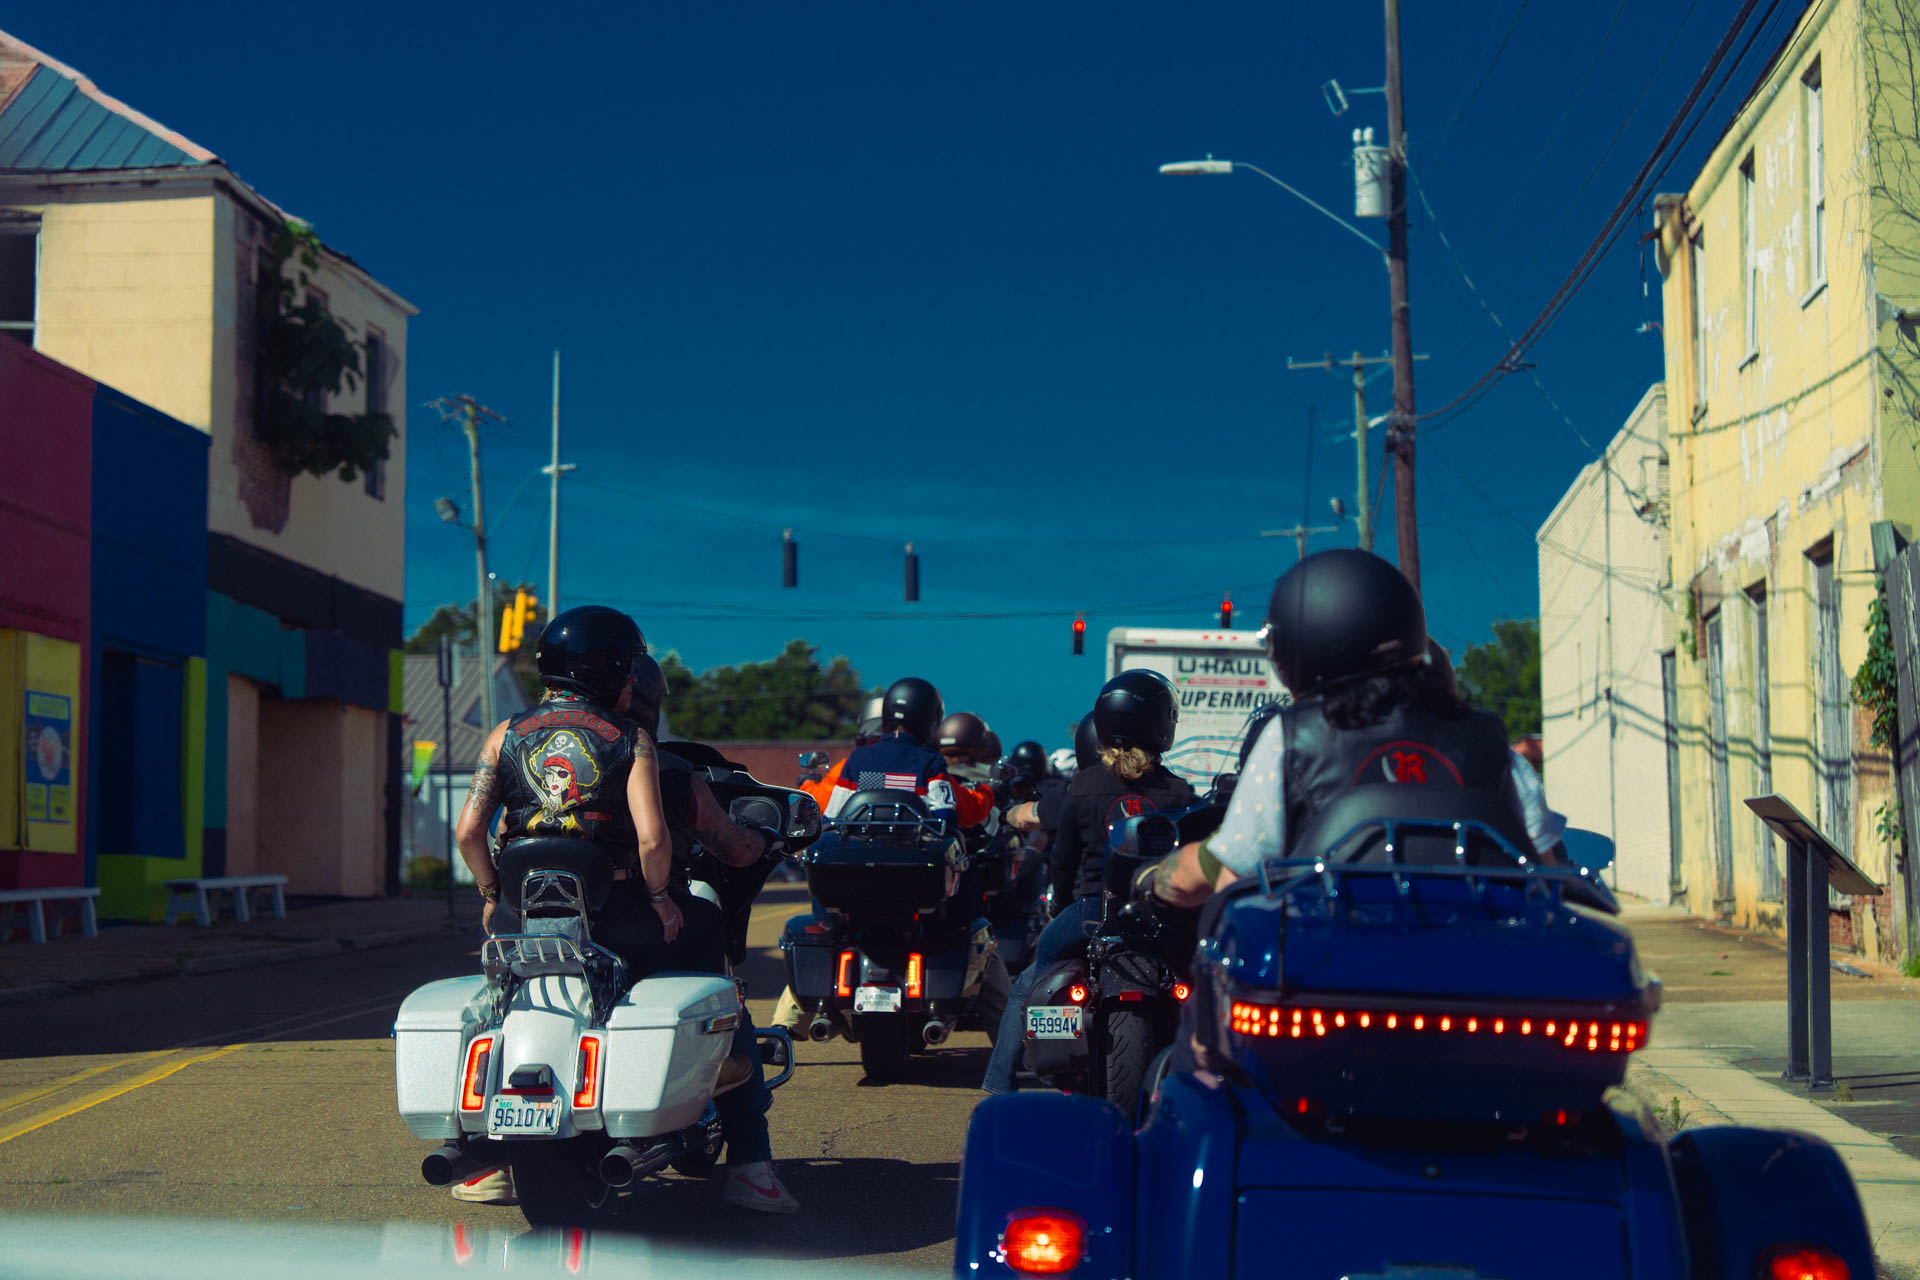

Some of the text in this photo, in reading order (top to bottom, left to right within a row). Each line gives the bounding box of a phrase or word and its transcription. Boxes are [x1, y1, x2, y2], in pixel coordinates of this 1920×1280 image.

[1178, 657, 1266, 675] U-HAUL
[1175, 689, 1293, 708] UPERMOVE
[1030, 1017, 1078, 1033] 95994W
[494, 1108, 554, 1127] 96107W
